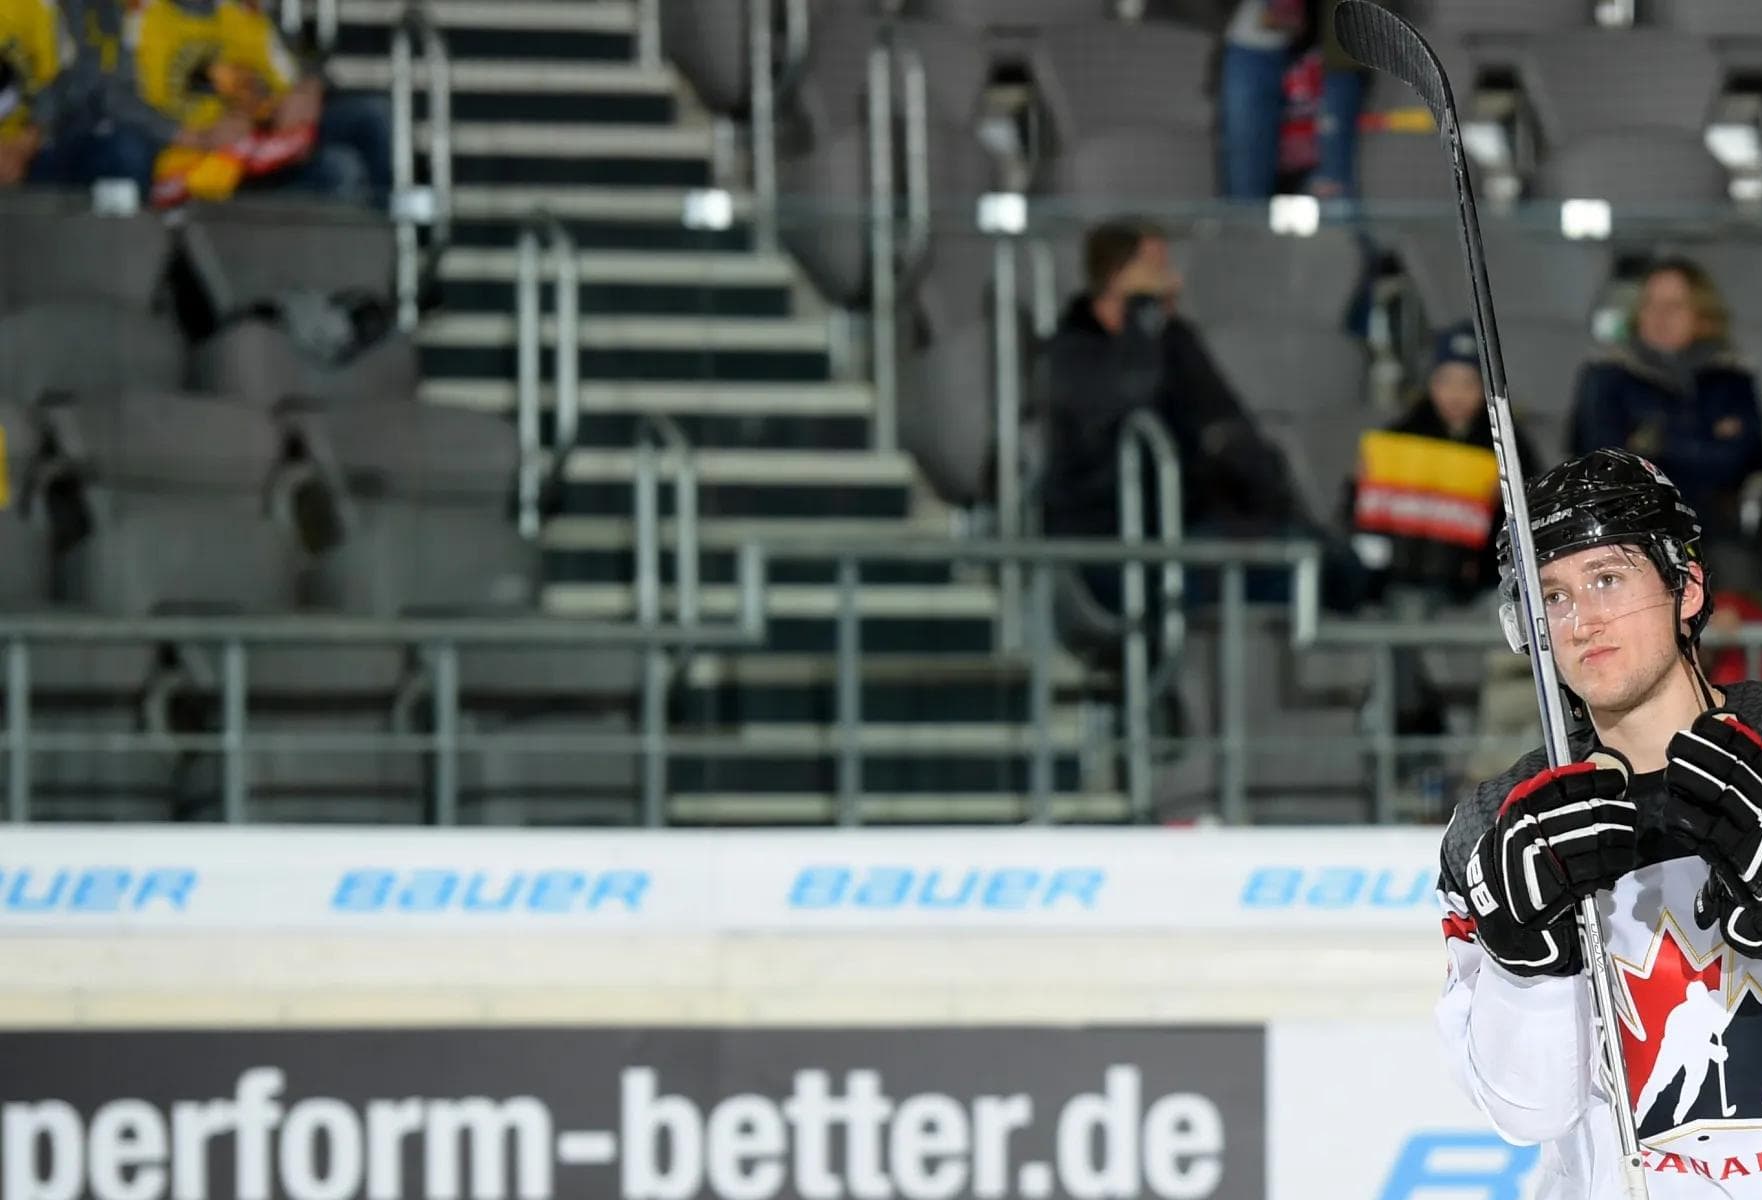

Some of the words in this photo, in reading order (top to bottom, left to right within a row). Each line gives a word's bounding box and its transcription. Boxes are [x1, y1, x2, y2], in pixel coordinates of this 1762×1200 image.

[0, 866, 200, 914] UER
[328, 868, 653, 914] BAUER
[786, 866, 1106, 911] BAUER
[1239, 867, 1440, 910] BAU
